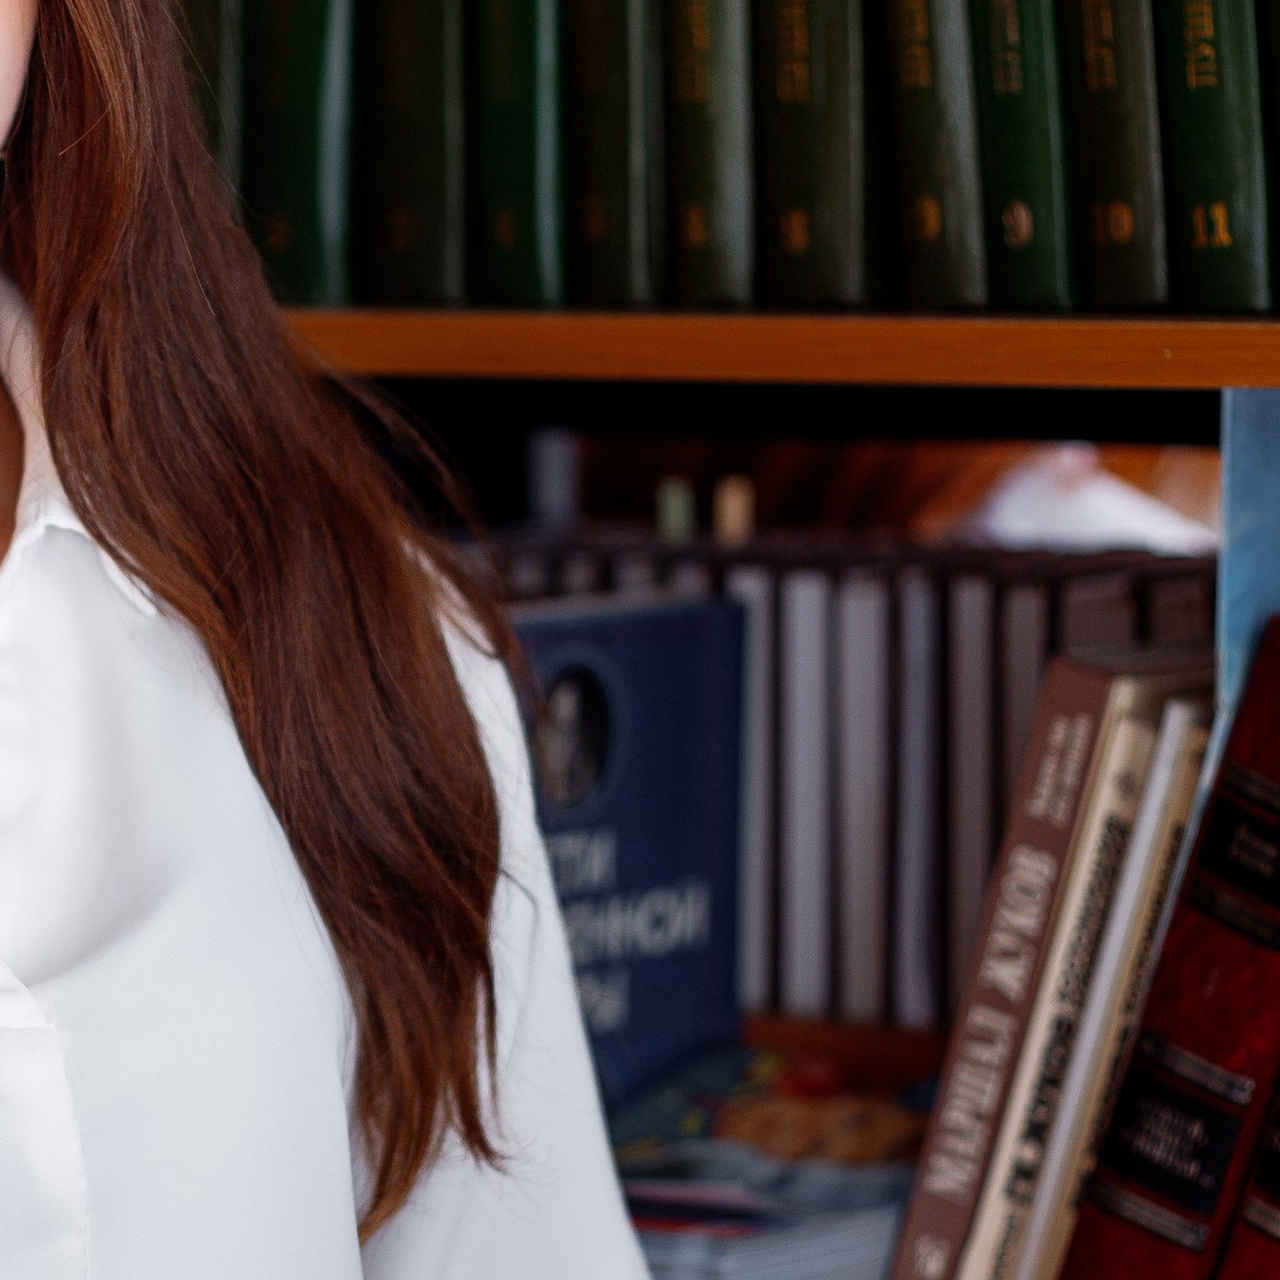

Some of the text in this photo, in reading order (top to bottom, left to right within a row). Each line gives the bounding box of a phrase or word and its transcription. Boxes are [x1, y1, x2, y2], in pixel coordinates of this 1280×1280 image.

[1190, 201, 1234, 249] 11
[925, 1005, 1022, 1199] МАРШАЛ
[981, 845, 1058, 1003] ЖУКОВ
